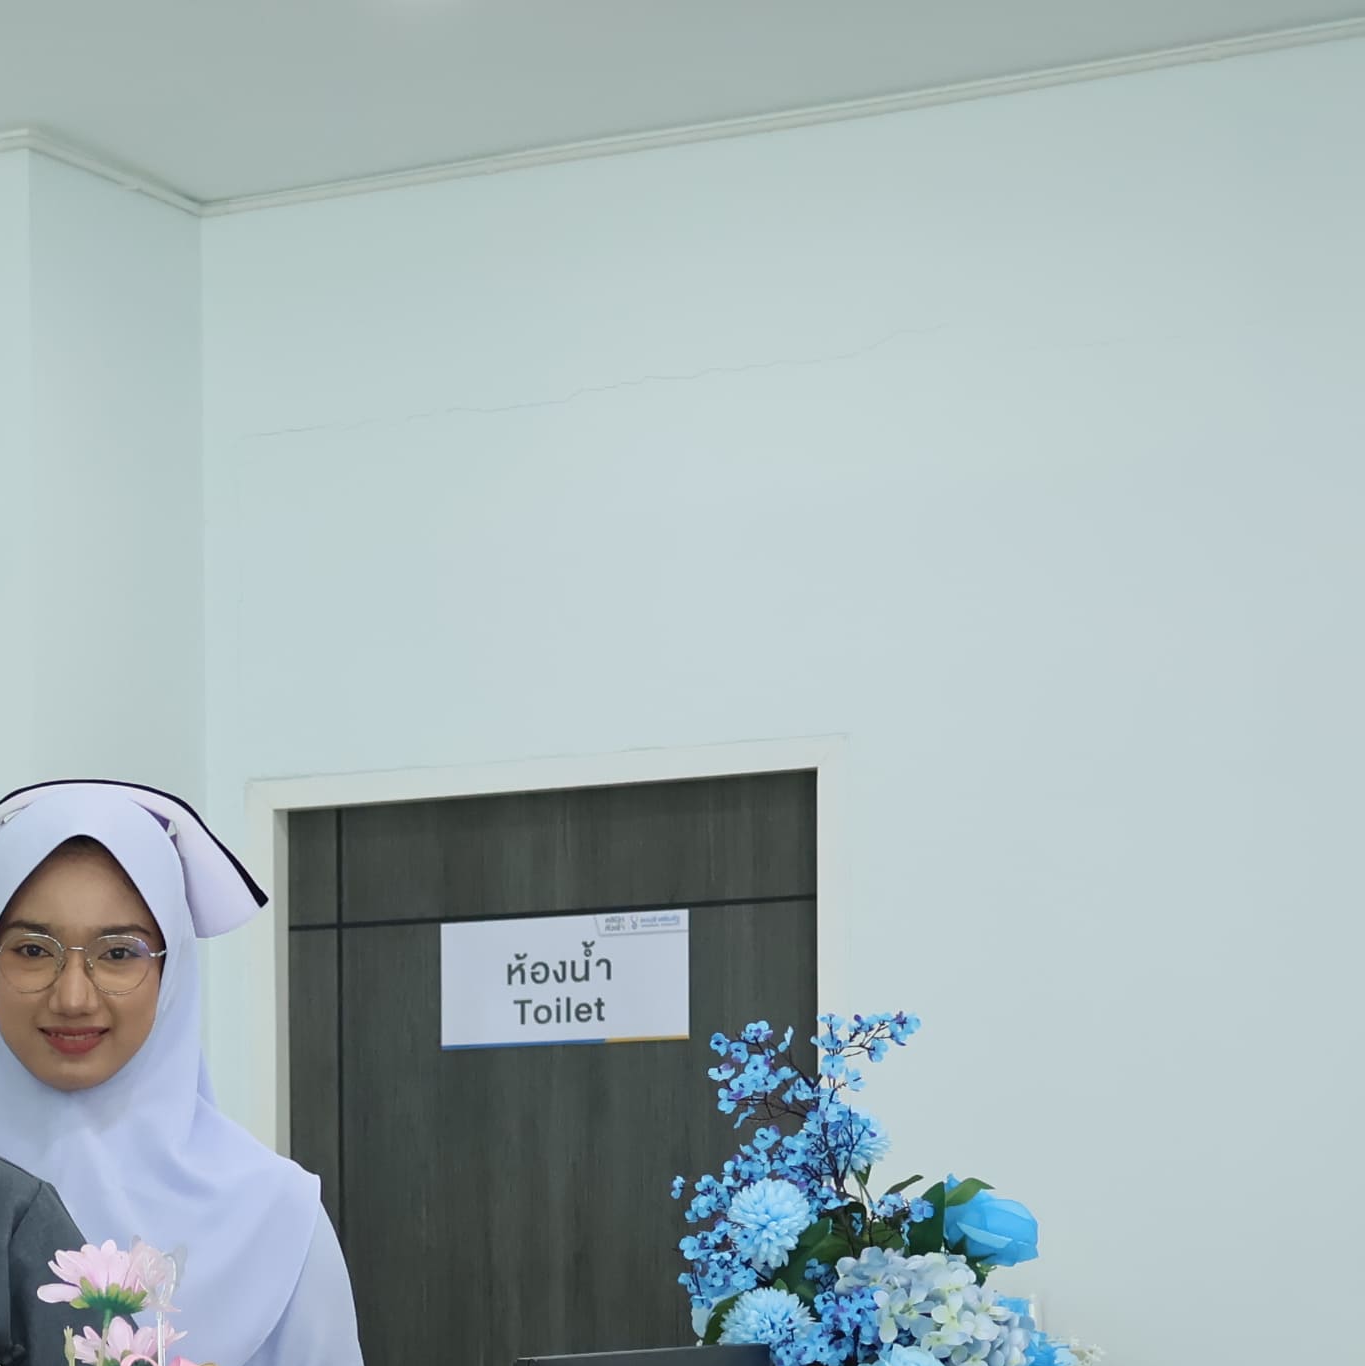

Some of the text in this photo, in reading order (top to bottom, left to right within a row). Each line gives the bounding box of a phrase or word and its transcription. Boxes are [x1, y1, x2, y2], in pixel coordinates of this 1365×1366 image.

[507, 941, 612, 986] ห้องน้ำ
[513, 997, 606, 1026] Toilet
